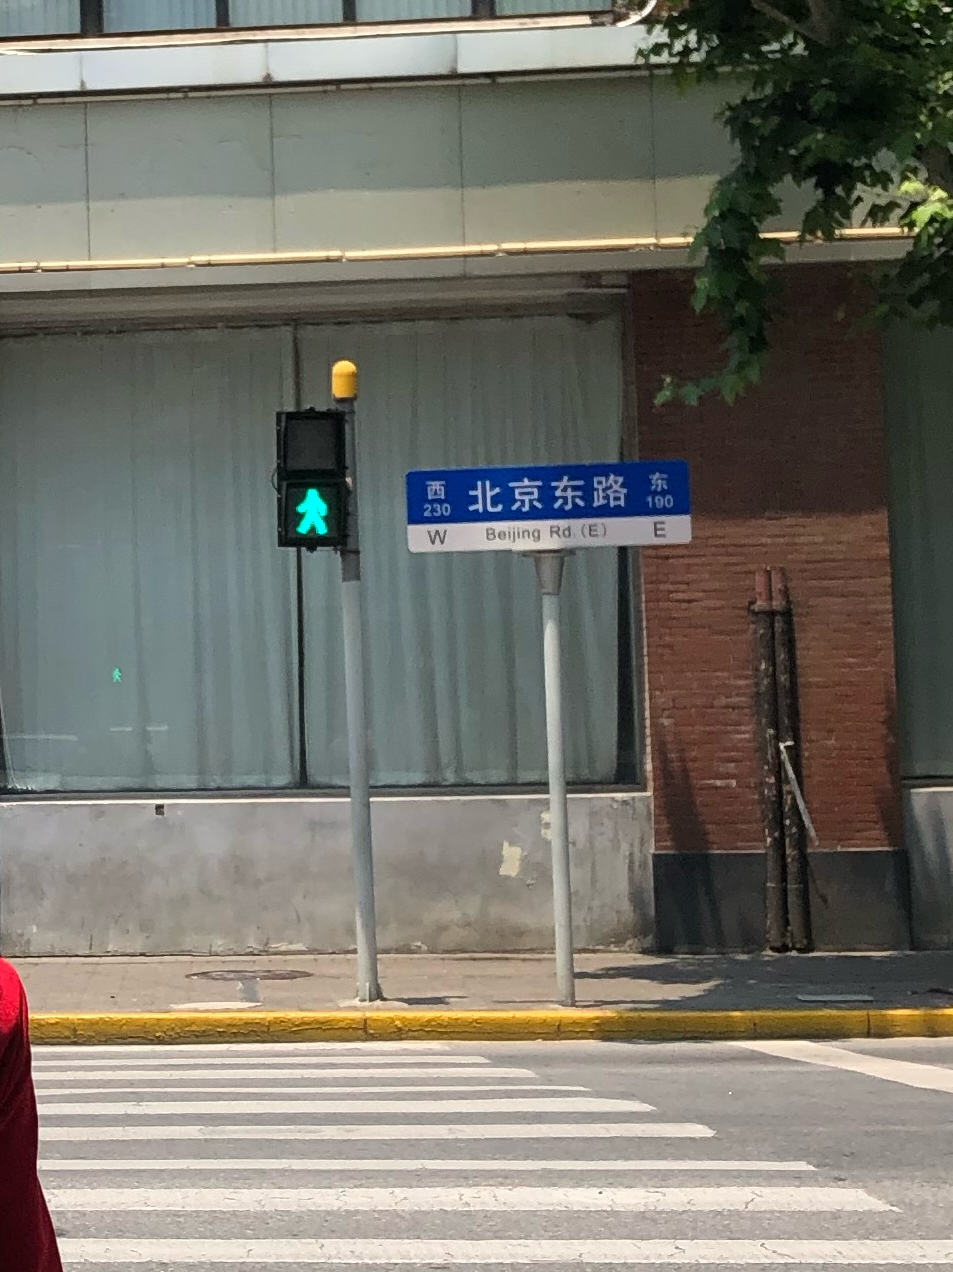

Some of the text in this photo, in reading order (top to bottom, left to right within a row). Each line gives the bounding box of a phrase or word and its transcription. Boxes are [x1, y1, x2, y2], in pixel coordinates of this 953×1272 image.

[425, 480, 446, 500] 西
[648, 471, 668, 492] 东
[468, 472, 628, 514] 北京东路
[646, 494, 674, 509] 190
[423, 503, 451, 517] 230
[426, 529, 447, 546] W
[485, 526, 541, 543] Beijing
[652, 520, 667, 538] E
